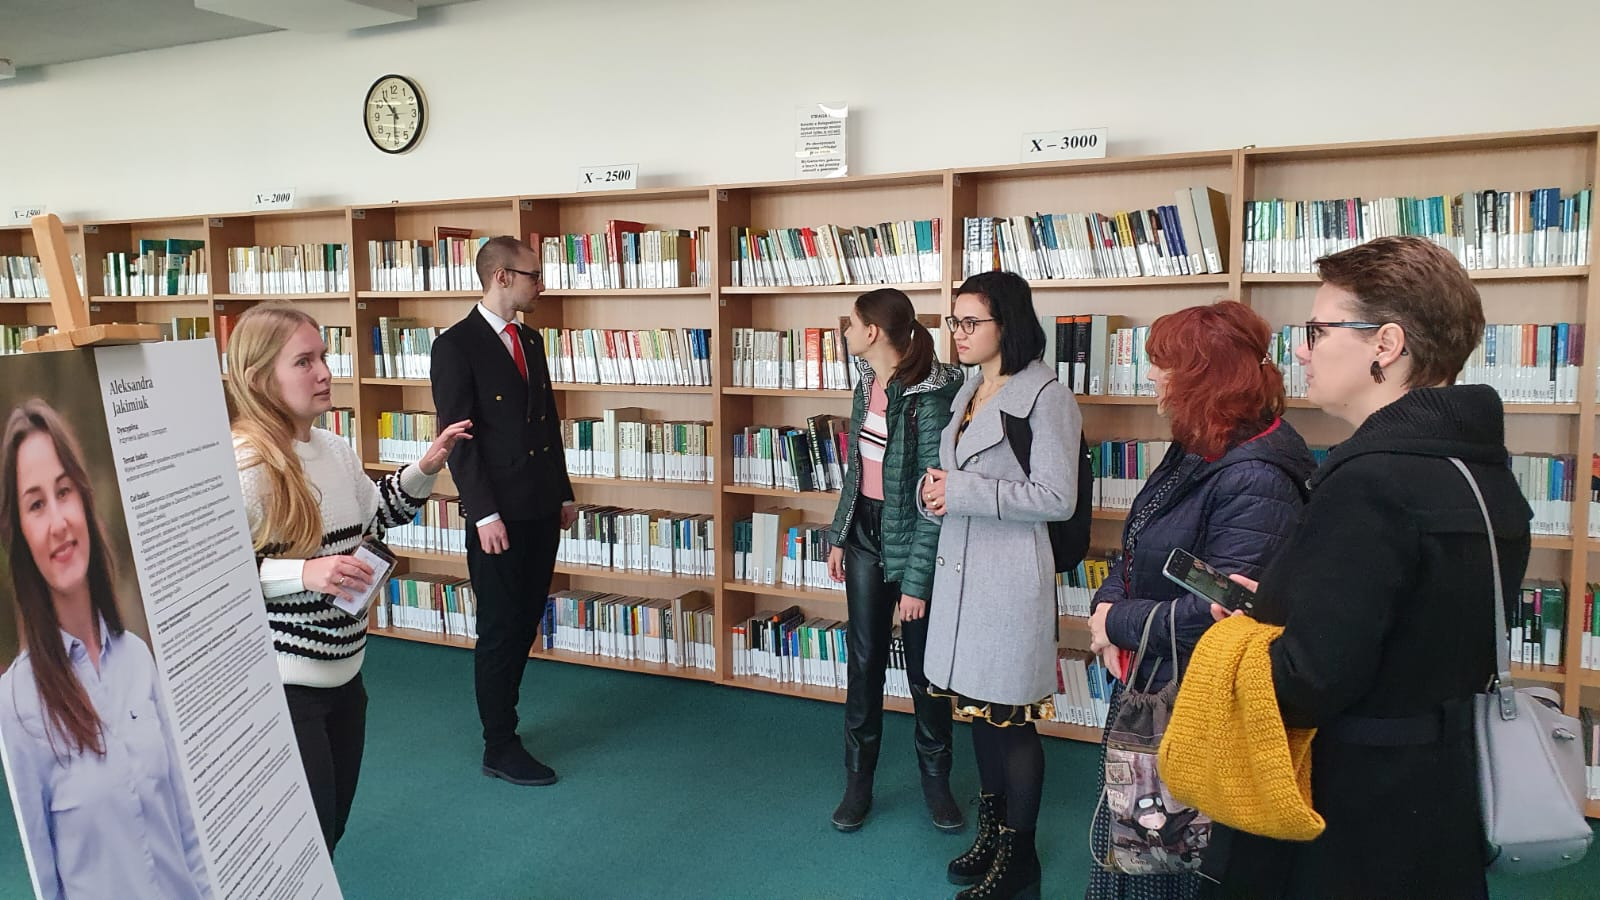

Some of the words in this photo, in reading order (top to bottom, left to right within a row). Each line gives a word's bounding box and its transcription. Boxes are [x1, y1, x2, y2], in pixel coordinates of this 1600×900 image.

[389, 84, 398, 95] 12
[402, 87, 406, 97] 1
[408, 96, 414, 106] 2
[374, 112, 380, 122] 9
[411, 108, 417, 118] 3
[378, 125, 384, 134] 8
[409, 121, 415, 130] 4
[385, 132, 391, 142] 7
[403, 130, 409, 140] 5
[1030, 139, 1044, 152] X
[1060, 134, 1098, 150] 3000
[583, 172, 594, 184] X
[605, 169, 631, 182] 2500
[255, 194, 263, 205] X
[271, 192, 291, 203] 2000
[109, 375, 154, 396] Aleksandra
[112, 395, 149, 418] Jakimiuk
